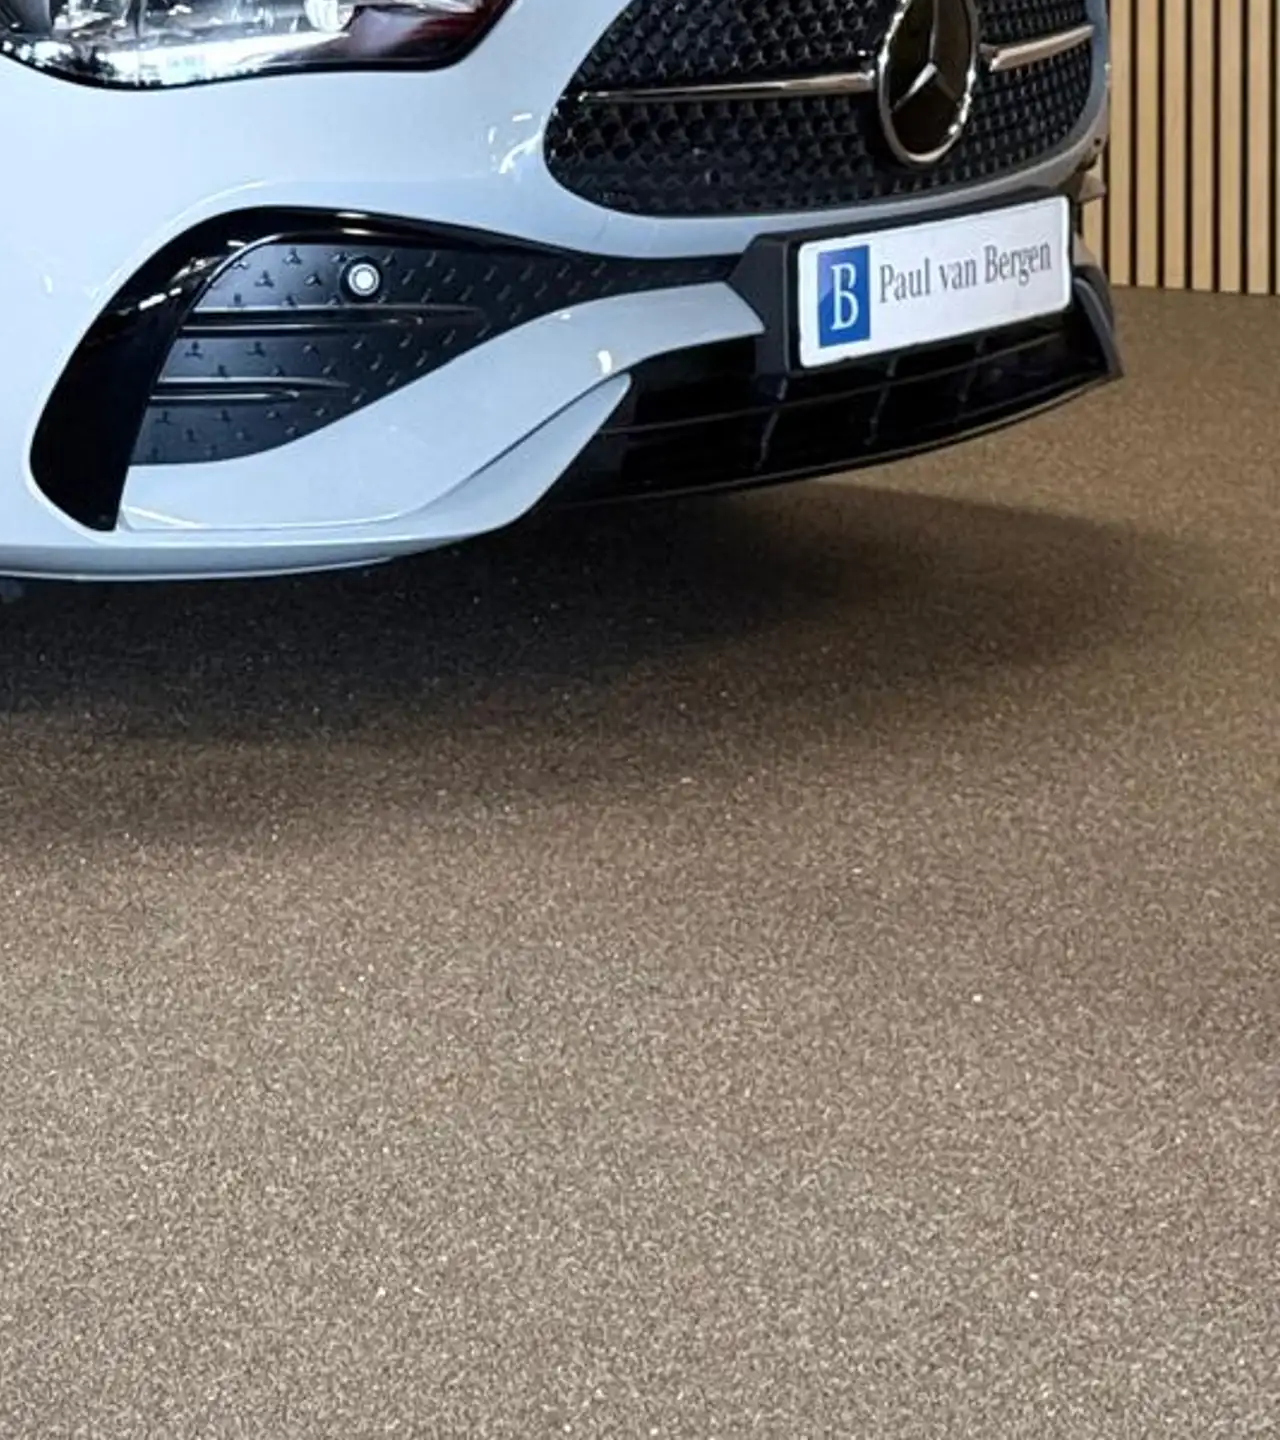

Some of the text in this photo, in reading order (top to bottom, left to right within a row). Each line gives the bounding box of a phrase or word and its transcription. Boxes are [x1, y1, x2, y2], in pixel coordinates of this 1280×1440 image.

[879, 242, 1053, 303] Paul van Bergen
